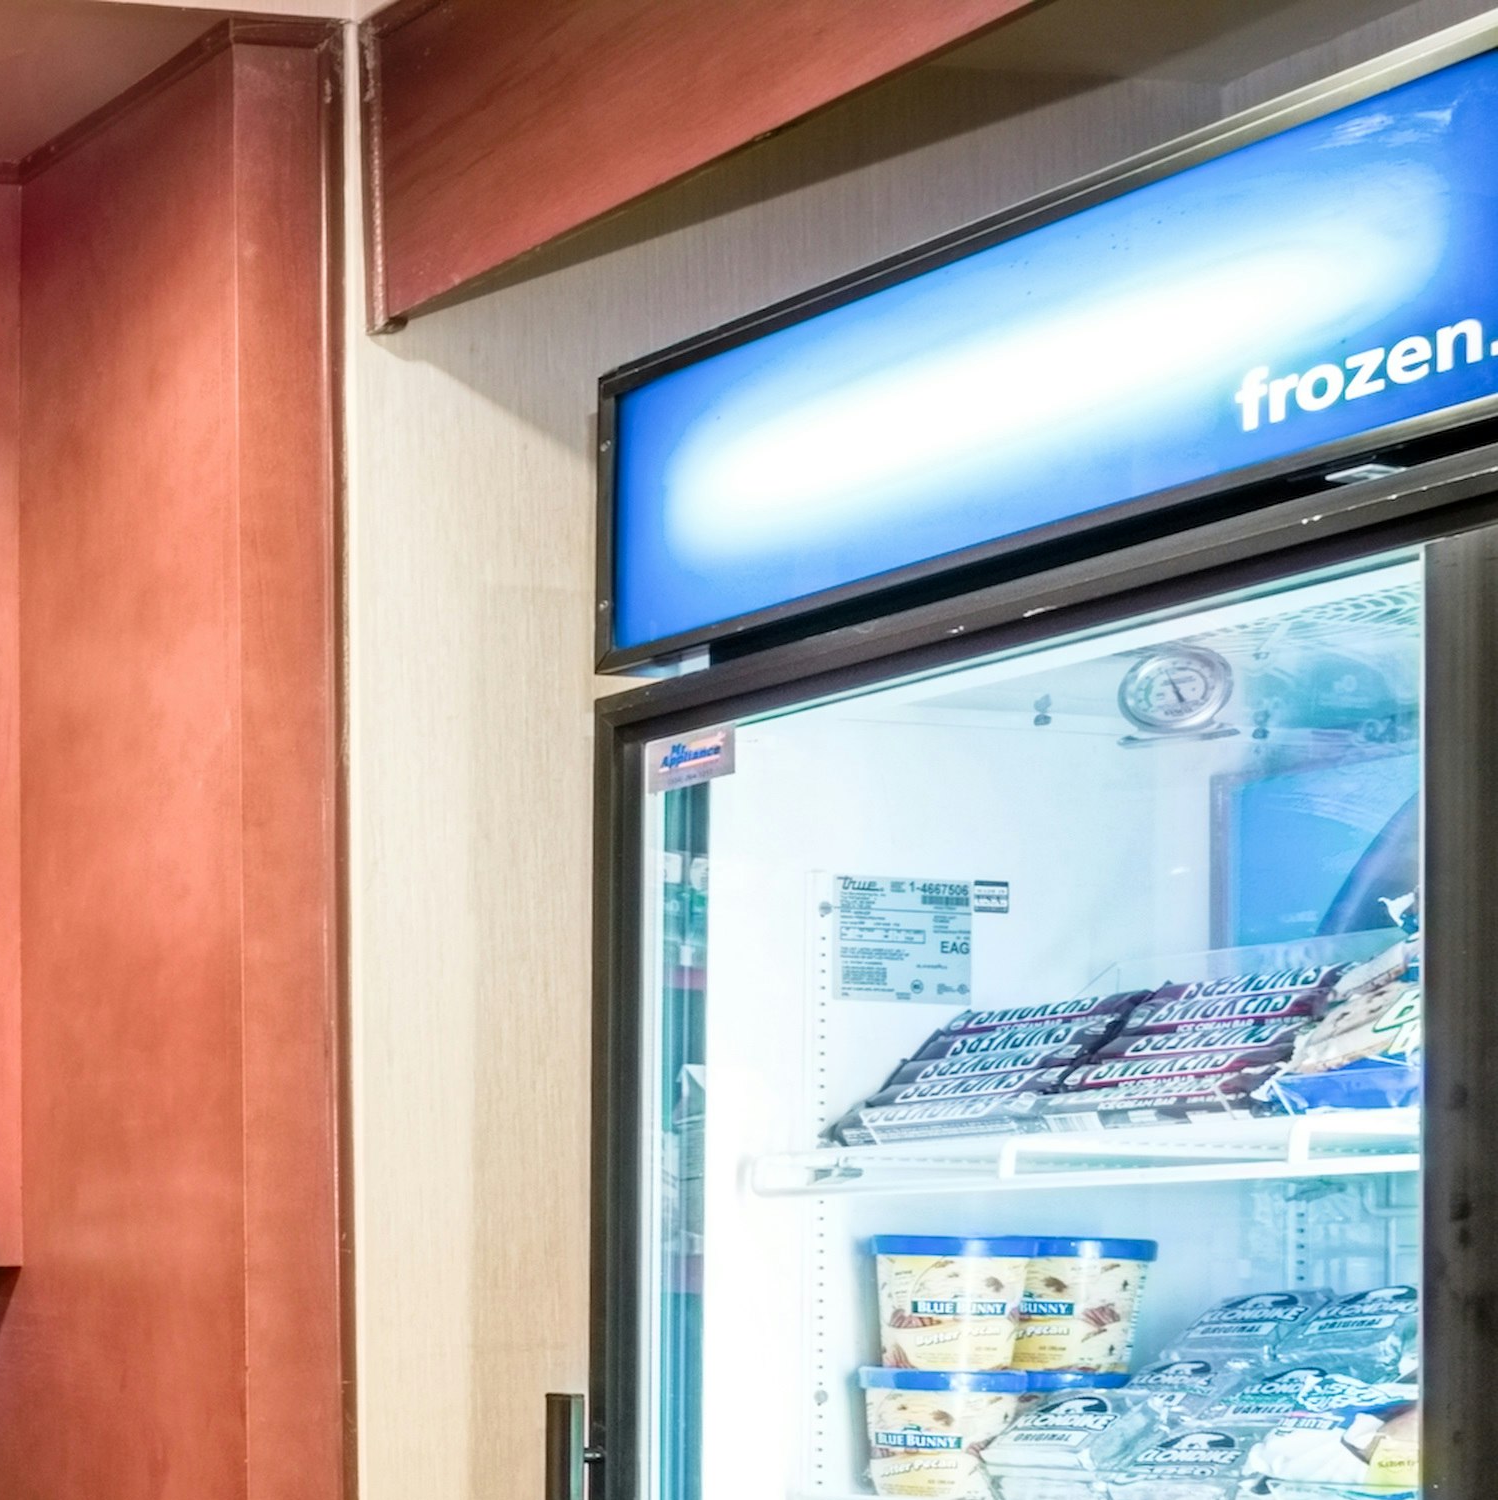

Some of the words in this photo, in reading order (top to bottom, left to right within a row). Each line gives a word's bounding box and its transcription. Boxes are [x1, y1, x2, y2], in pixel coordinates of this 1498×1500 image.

[659, 744, 722, 769] Appliance
[908, 881, 970, 897] 1-4667506
[940, 940, 971, 955] EAG
[916, 1300, 954, 1314] BLUE
[1019, 1302, 1069, 1315] BUNNY
[1203, 1306, 1306, 1323] KLONDIKE
[1015, 1413, 1117, 1431] KLONDIKE
[876, 1433, 905, 1446] BLUE
[906, 1434, 958, 1449] BUNNY
